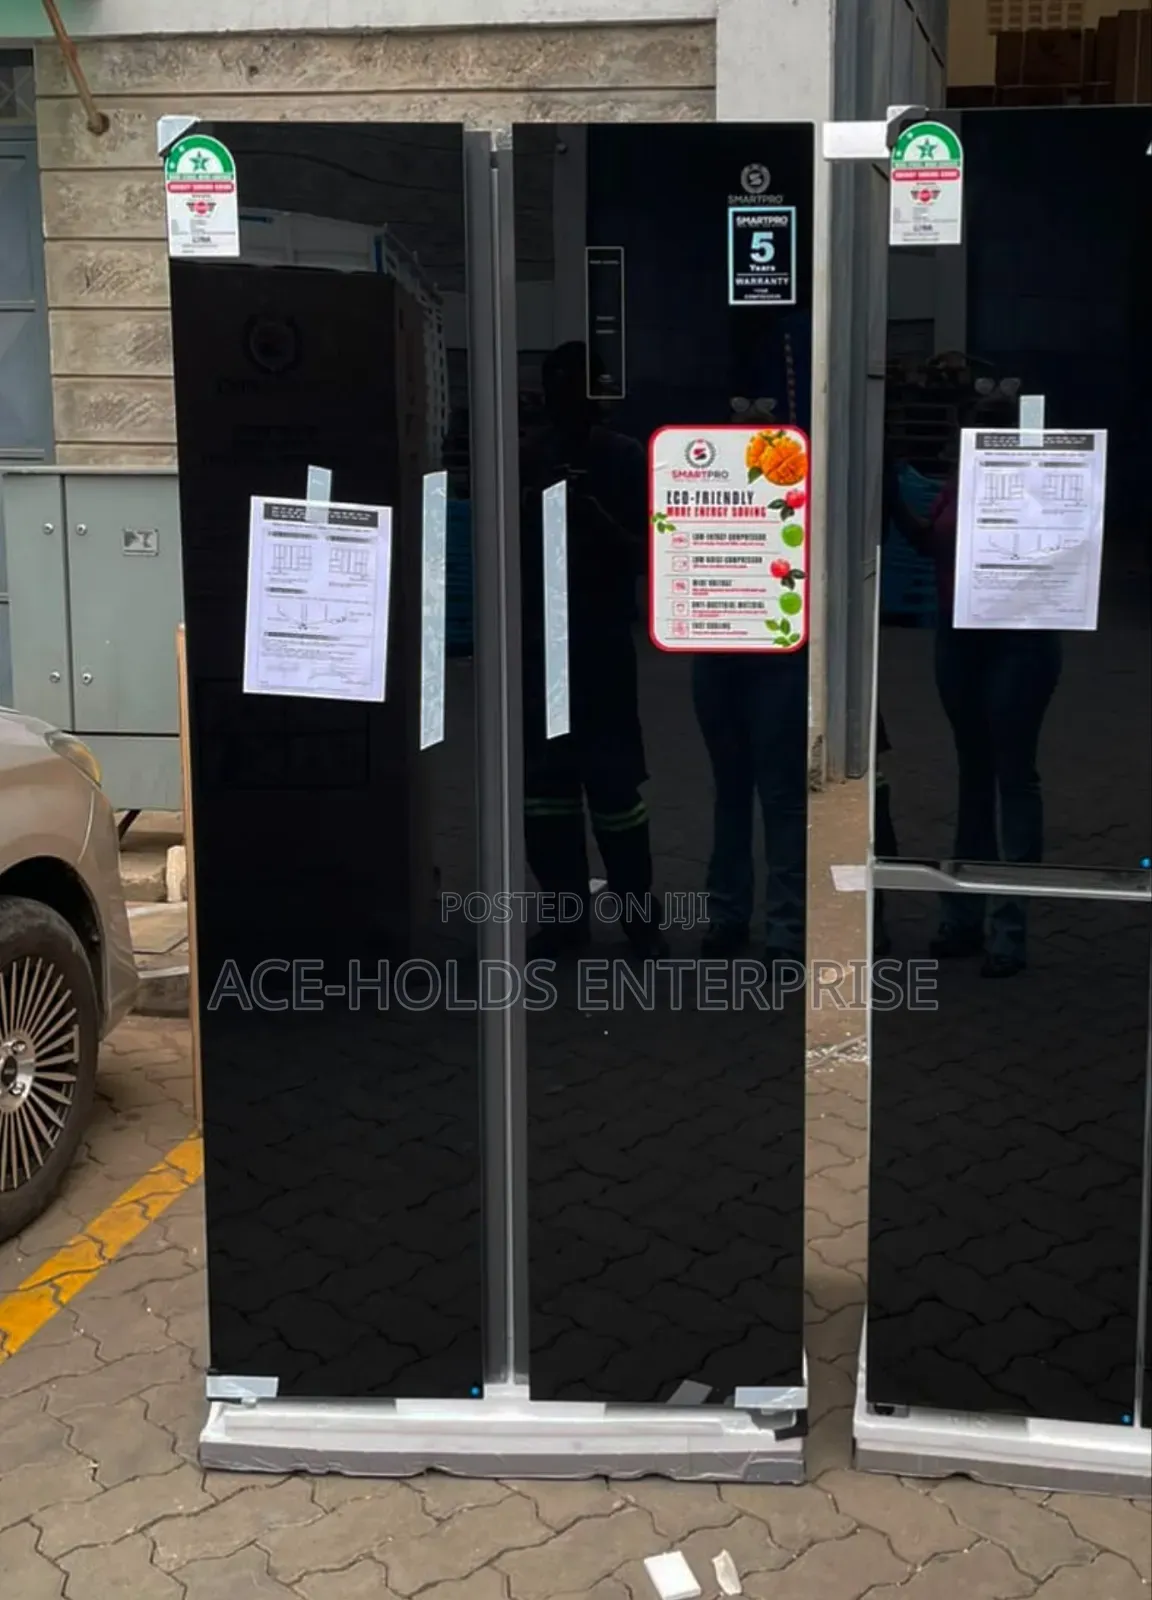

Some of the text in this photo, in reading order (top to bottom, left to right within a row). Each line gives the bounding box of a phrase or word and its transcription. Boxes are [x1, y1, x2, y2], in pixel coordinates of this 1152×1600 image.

[728, 194, 783, 204] SMARTPRO
[735, 215, 789, 226] SMARTPRO
[750, 231, 775, 263] 5
[749, 264, 776, 272] Years
[735, 277, 789, 286] WARRANTY
[672, 470, 729, 479] SMARTPRO
[667, 490, 754, 505] ECO-FRIENDLY
[667, 506, 691, 517] MORE
[694, 506, 728, 517] ENERGY
